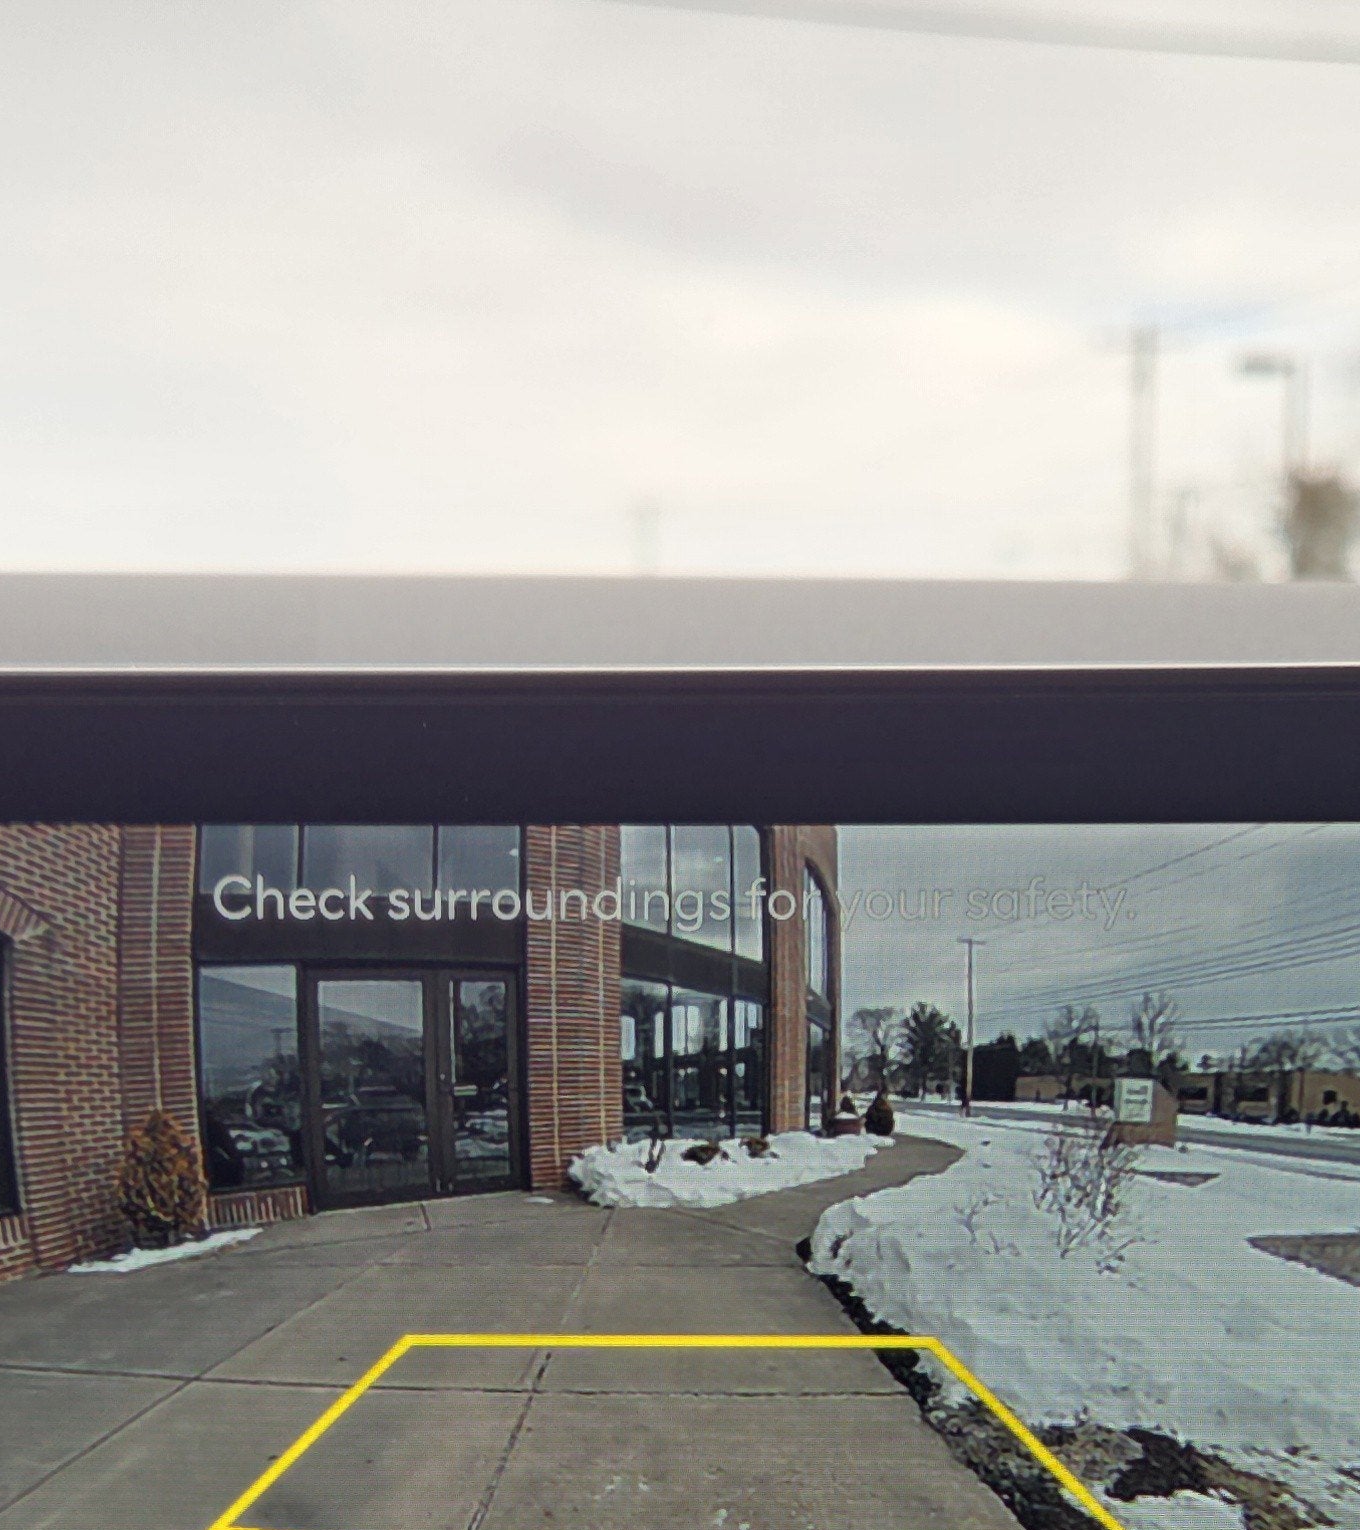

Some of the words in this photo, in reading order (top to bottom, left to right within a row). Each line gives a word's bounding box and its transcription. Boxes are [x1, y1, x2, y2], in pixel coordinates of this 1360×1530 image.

[212, 872, 373, 922] Check
[387, 874, 732, 932] surroundings
[745, 876, 822, 922] for
[834, 887, 955, 931] your
